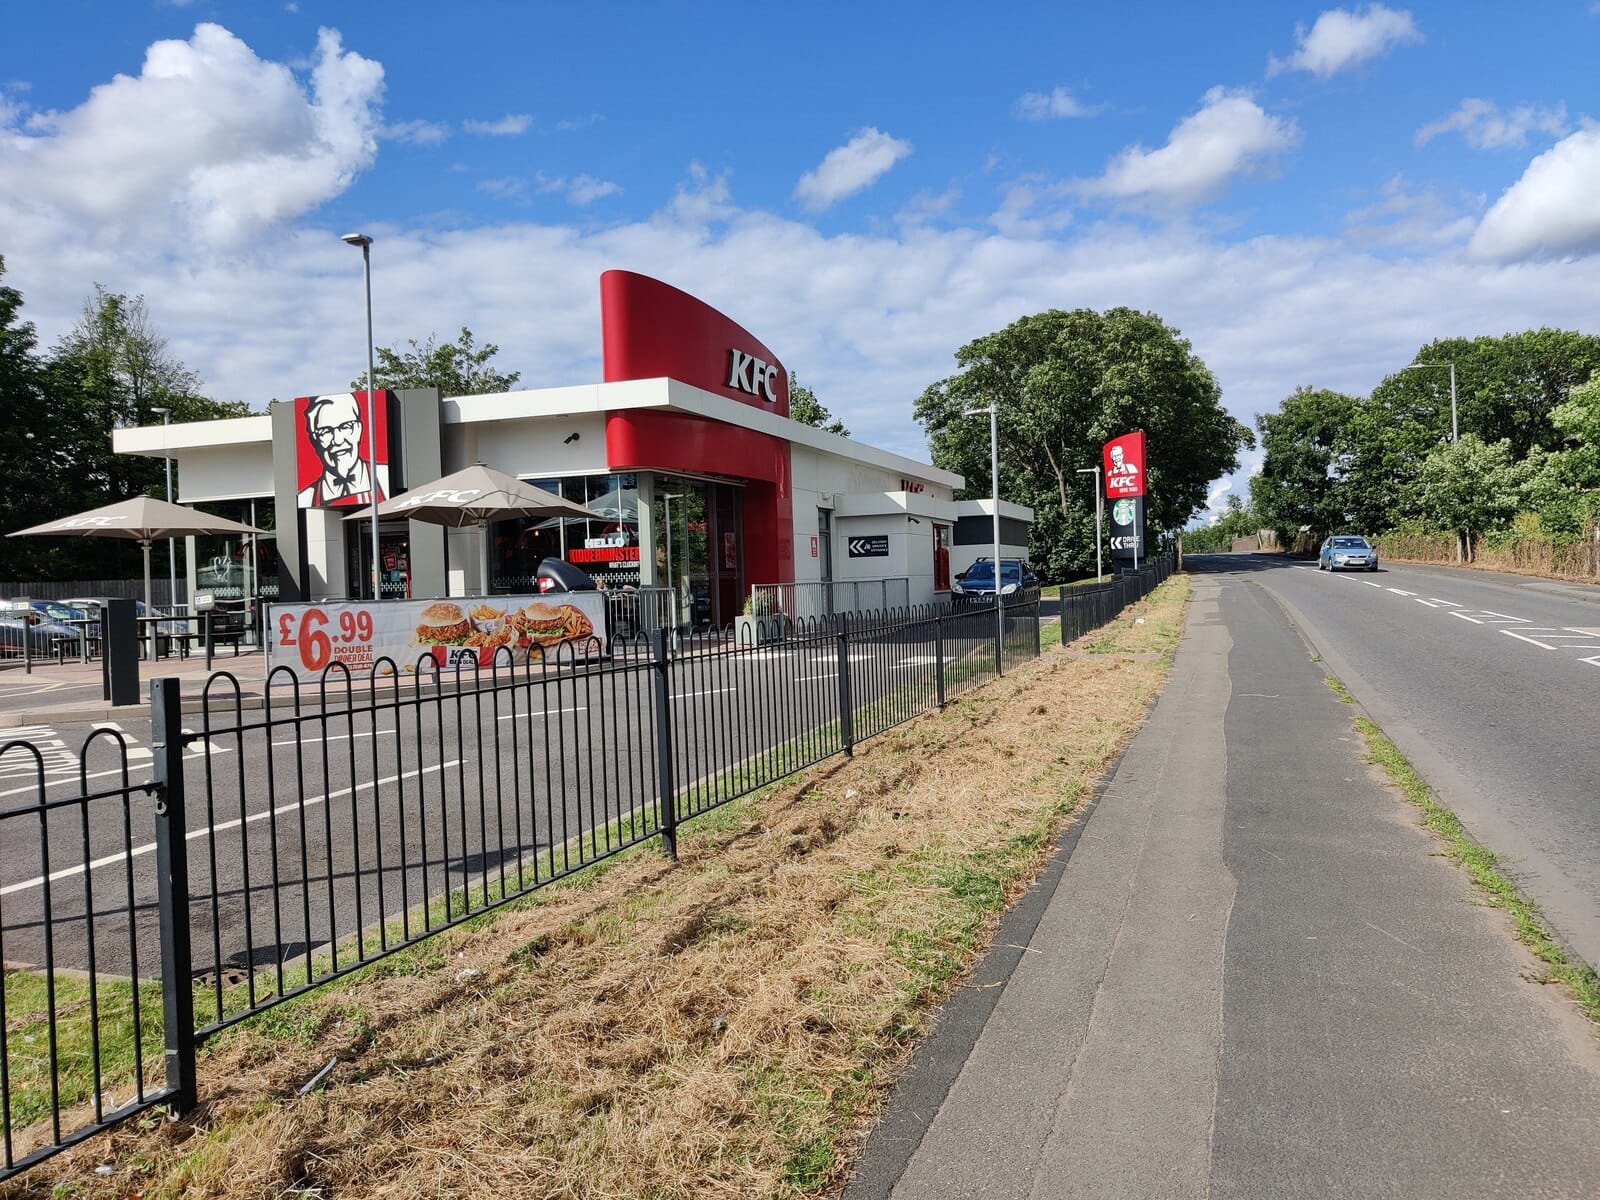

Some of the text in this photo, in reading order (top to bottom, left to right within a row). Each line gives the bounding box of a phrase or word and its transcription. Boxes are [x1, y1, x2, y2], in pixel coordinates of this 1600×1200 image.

[728, 348, 778, 402] KFC
[1110, 476, 1135, 488] KFC
[393, 489, 480, 508] KFC
[52, 516, 128, 528] KFC
[584, 537, 625, 548] HELLO
[279, 608, 374, 672] £6.99
[333, 645, 374, 654] DOUBLE
[449, 649, 478, 659] KFC
[334, 653, 374, 662] DINNER DEAL
